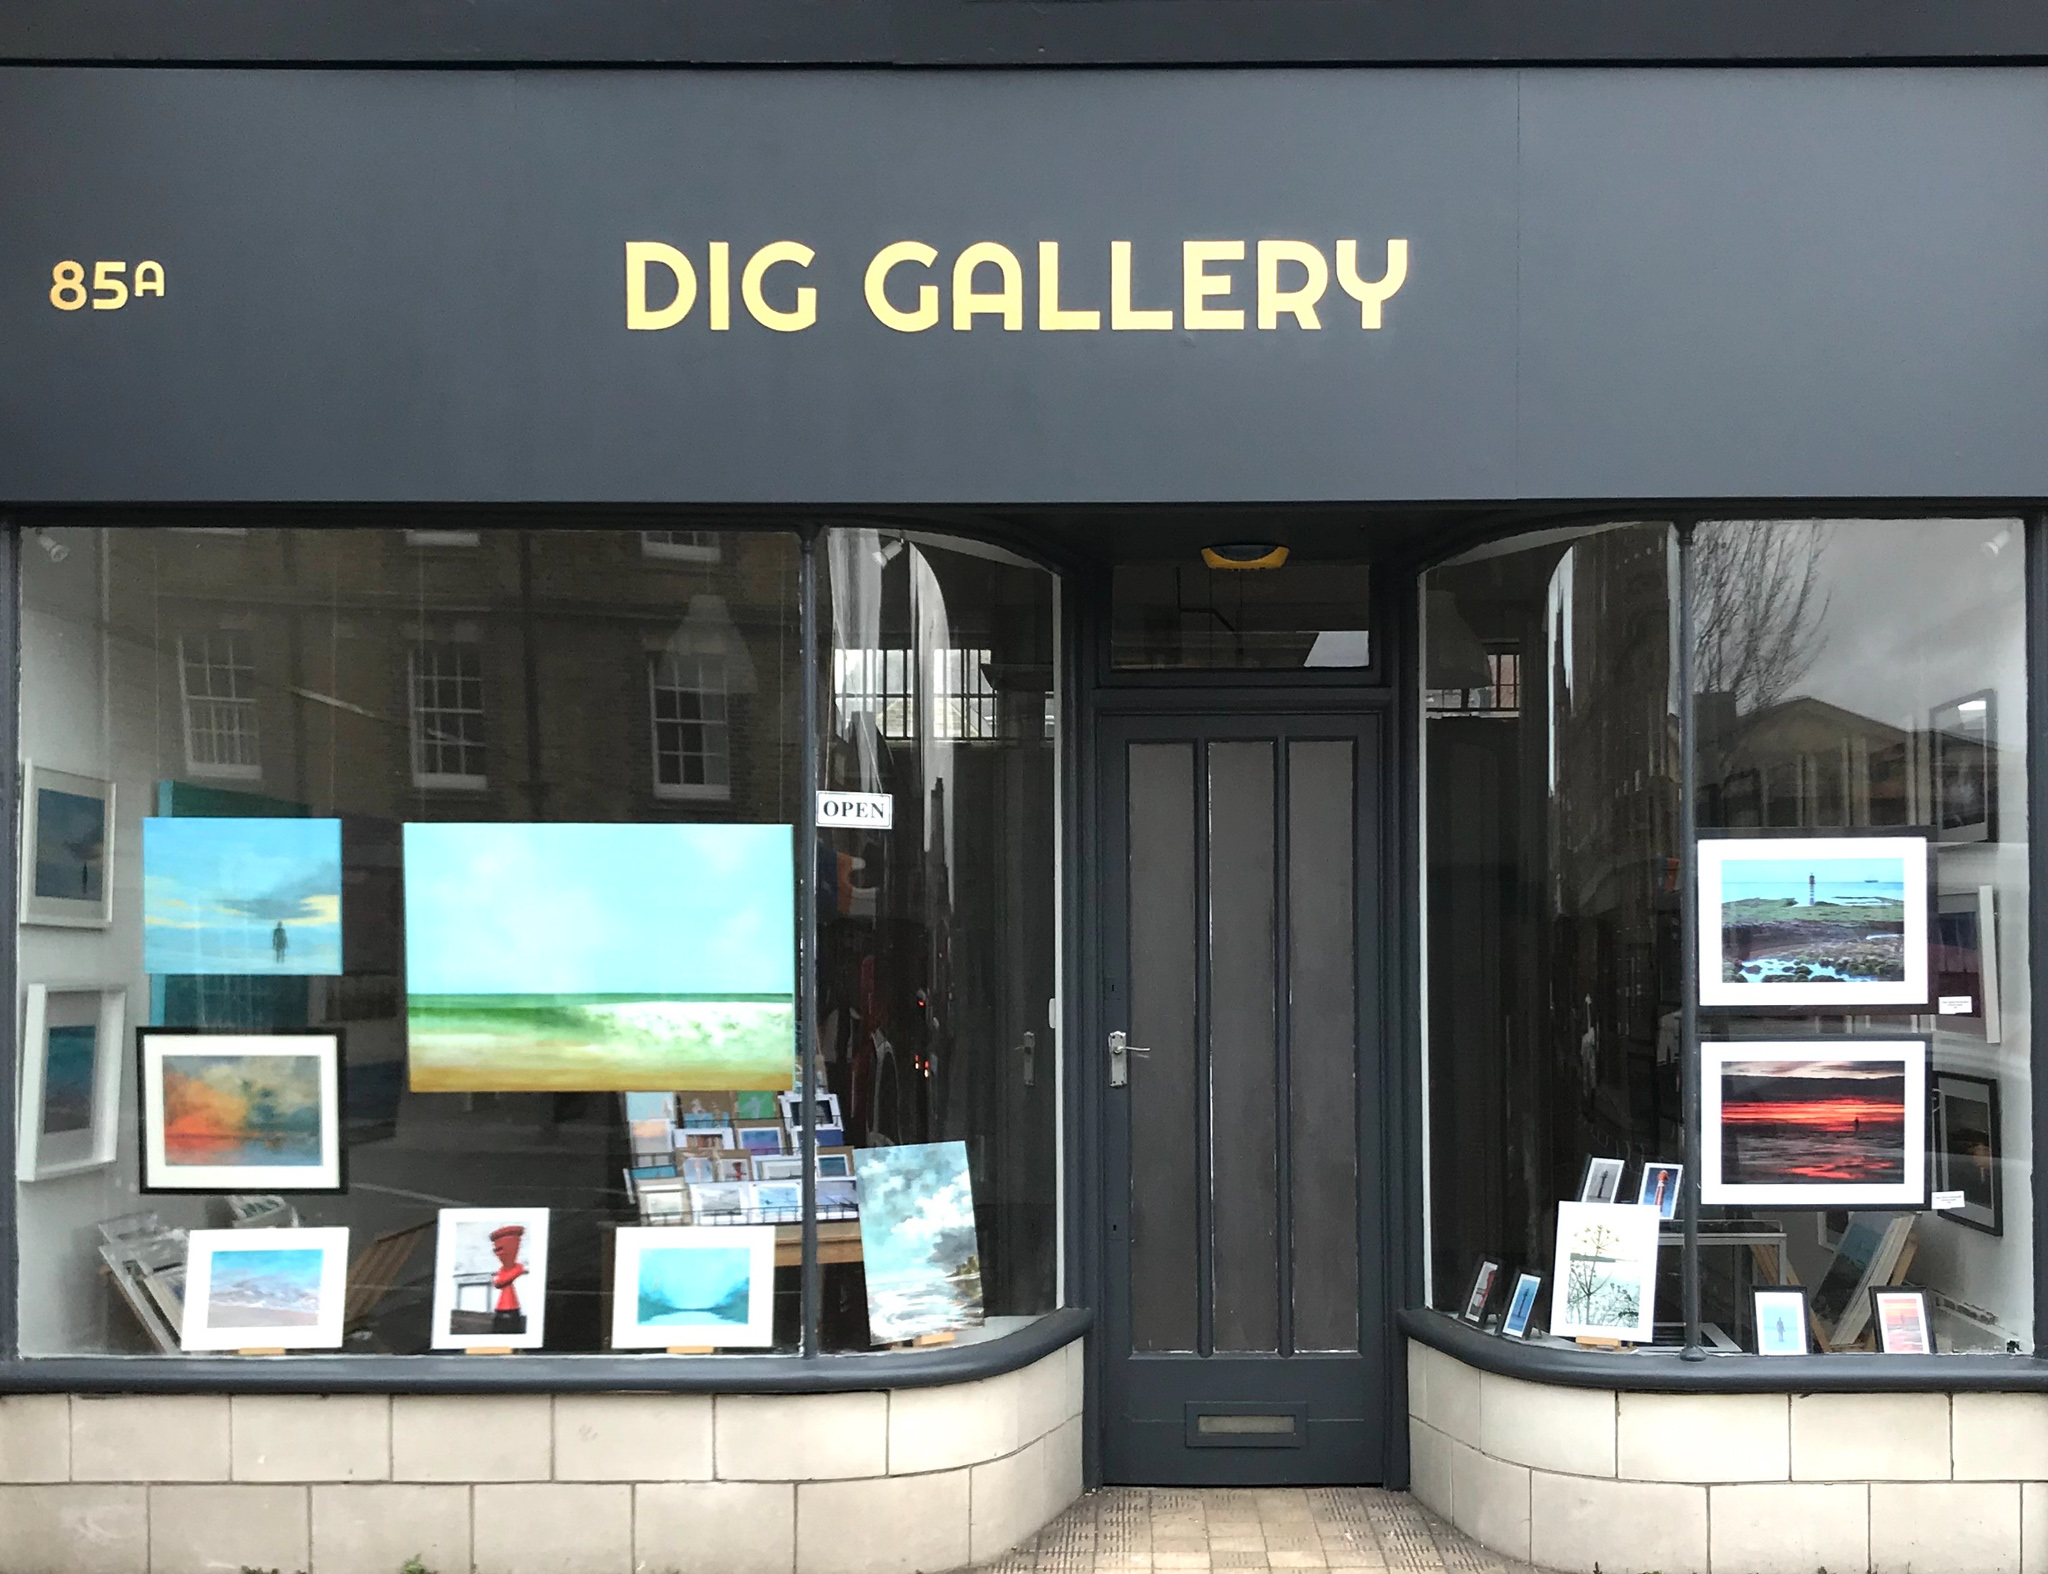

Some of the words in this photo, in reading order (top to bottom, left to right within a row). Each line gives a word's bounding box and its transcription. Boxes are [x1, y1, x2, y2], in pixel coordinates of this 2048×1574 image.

[49, 259, 166, 311] 85A
[625, 240, 817, 333] DIG
[864, 238, 1409, 333] GALLERY
[823, 800, 885, 819] OPEN
